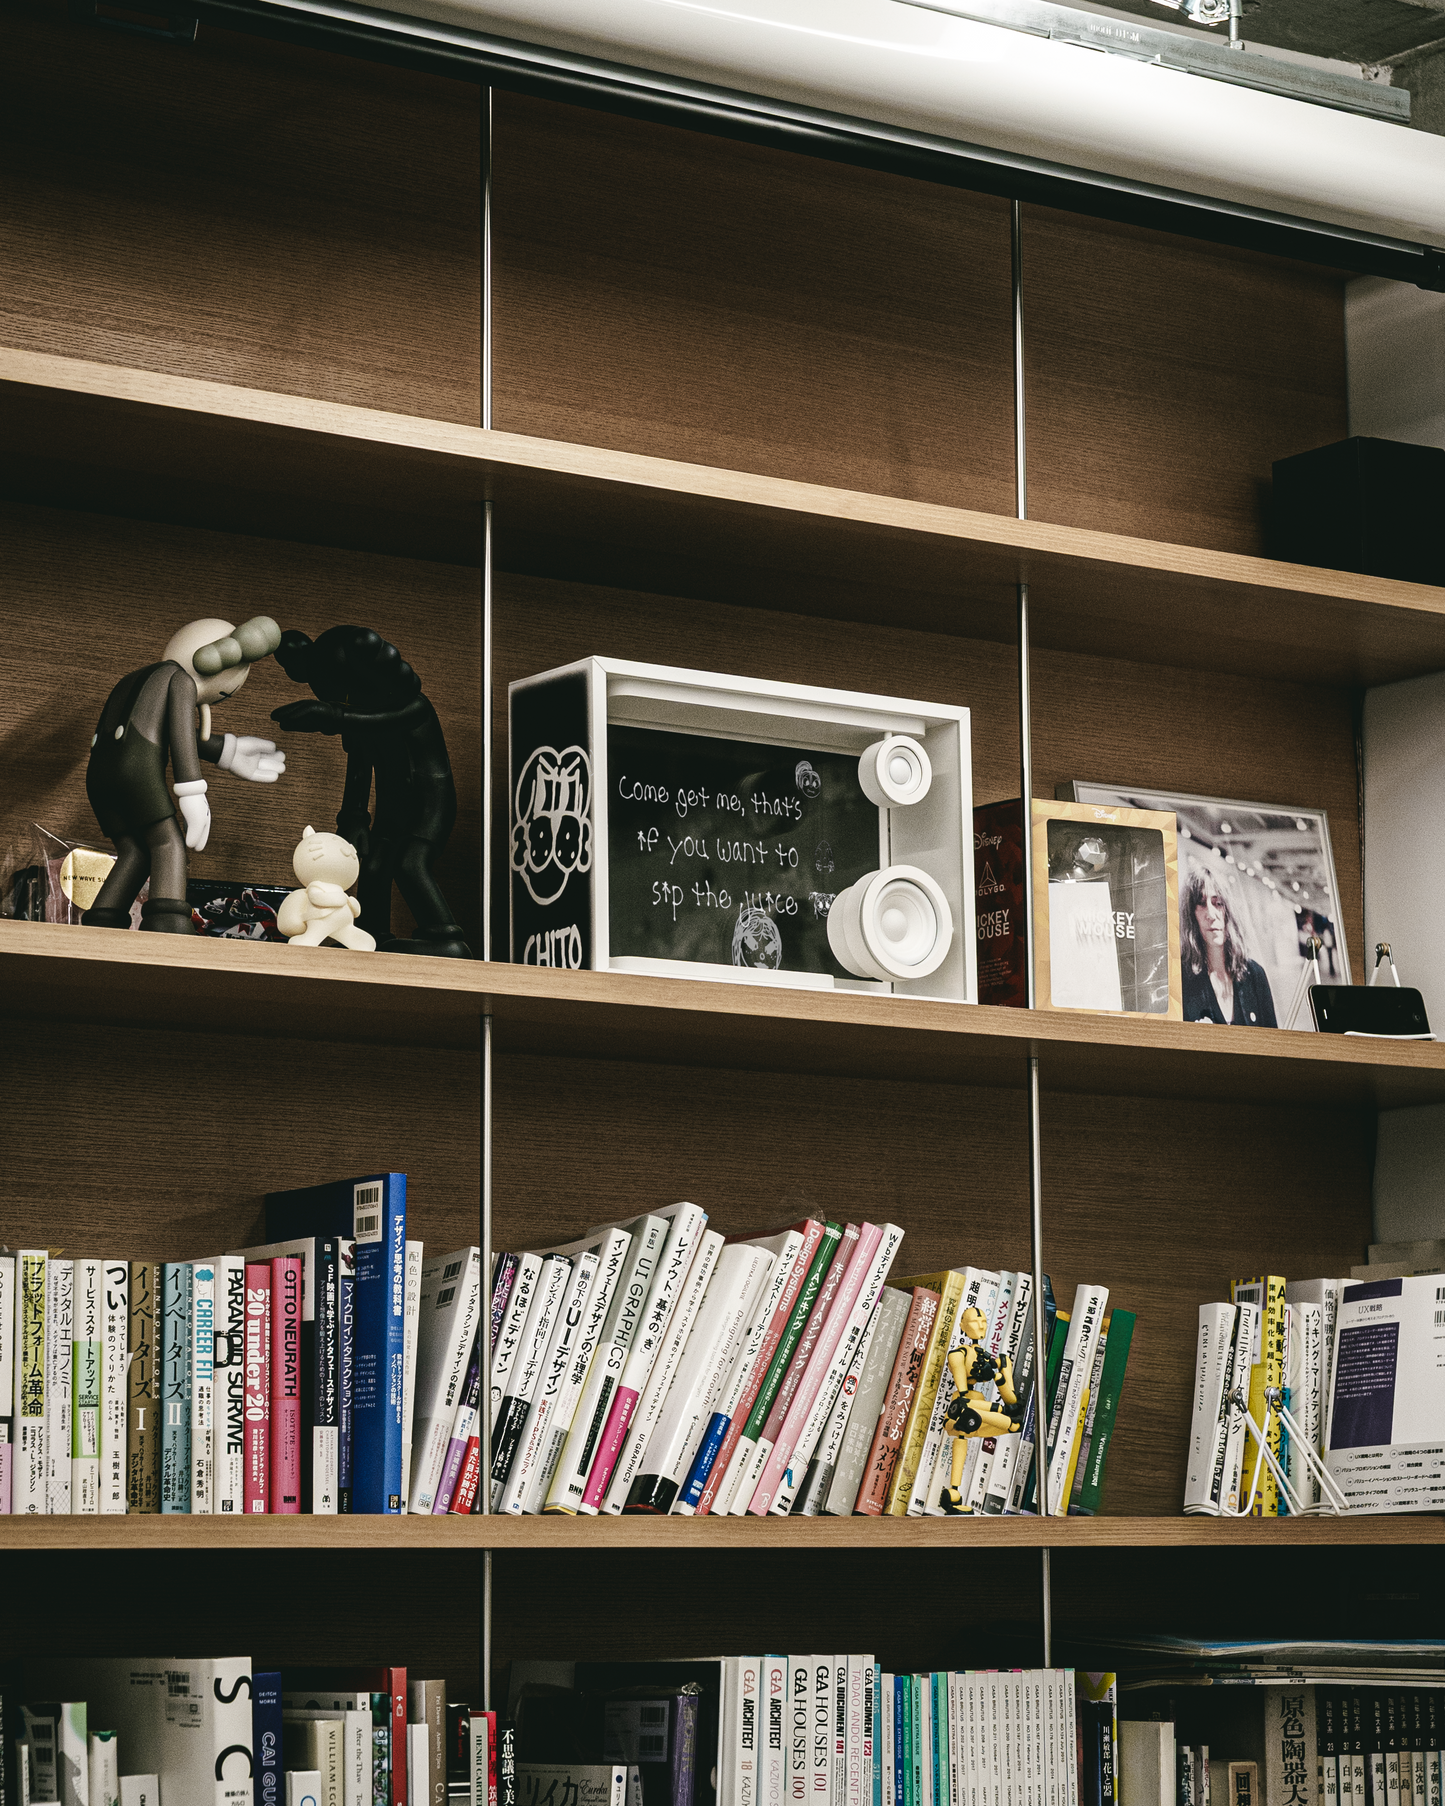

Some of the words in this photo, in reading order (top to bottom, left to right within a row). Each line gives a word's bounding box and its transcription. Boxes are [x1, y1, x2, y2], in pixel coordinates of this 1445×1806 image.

[618, 775, 669, 804] Come
[676, 786, 710, 818] get
[716, 790, 746, 816] me,
[751, 791, 802, 820] that's
[1091, 807, 1117, 821] Disney
[637, 827, 659, 852] if
[668, 836, 708, 864] you
[717, 836, 768, 865] want
[774, 841, 800, 868] to
[79, 875, 96, 883] WAVE
[652, 879, 684, 922] sip
[691, 879, 731, 910] the
[739, 890, 798, 928] juice
[977, 909, 1010, 928] ICKEY
[524, 922, 582, 968] CHITO
[978, 925, 1010, 941] OUSE
[392, 1215, 404, 1316] デザイン思考の教科書
[635, 1257, 653, 1279] UI
[798, 1229, 820, 1268] Design
[247, 1288, 265, 1316] 20
[284, 1269, 297, 1315] OTTO
[406, 1251, 420, 1316] 配色の設計
[639, 1236, 689, 1355] レイアウト、基本の「き」
[746, 1244, 798, 1356] デザインはストーリーテリング
[779, 1265, 805, 1313] Systems
[792, 1263, 824, 1331] IAシンキング
[913, 1295, 923, 1317] WHAT
[85, 1266, 96, 1389] サービス・スタートアップ
[196, 1299, 213, 1354] CAREER
[228, 1268, 243, 1366] PARANOID
[496, 1267, 536, 1374] なるほどデザイン
[518, 1266, 564, 1397] オブジェクト指向UIデザイン
[570, 1238, 626, 1385] インタフェースデザインの心理学
[607, 1283, 644, 1370] GRAPHICS
[795, 1262, 844, 1370] モバイルIAシンキング
[1358, 1303, 1383, 1315] UX戦略
[29, 1259, 45, 1417] プラットフォーム革命
[60, 1266, 73, 1399] デジタルエコノミー
[107, 1314, 116, 1393] 体験のつくりかた
[132, 1266, 153, 1399] イノベーターズ
[165, 1268, 186, 1400] イノベーターズ
[246, 1318, 264, 1391] under
[325, 1264, 335, 1423] SF映画で学ぶインタフェースデザイン
[342, 1282, 354, 1408] マイクロインタラクション
[545, 1269, 591, 1396] 縁の下のUIデザイン
[720, 1309, 744, 1356] Designing
[904, 1318, 916, 1350] MATTERS
[196, 1360, 213, 1383] FIT
[284, 1318, 296, 1397] NEURATH
[714, 1356, 726, 1370] for
[889, 1297, 938, 1441] 経営は何をすべきか
[1310, 1309, 1321, 1444] ハッキング・マーケティング
[227, 1371, 243, 1455] SURVIVE
[246, 1394, 264, 1421] 20
[639, 1433, 646, 1442] UI
[874, 1444, 889, 1472] ハメル
[112, 1451, 120, 1500] 玉樹真一郎
[130, 1453, 139, 1508] デジタル革命史
[163, 1448, 171, 1502] デジタル革命史
[196, 1459, 205, 1499] 石倉秀明
[622, 1442, 643, 1484] GRAPHICS
[568, 1484, 584, 1496] BNN
[743, 1669, 756, 1696] GA
[770, 1668, 783, 1696] GA
[794, 1668, 808, 1697] GA
[815, 1665, 830, 1693] GA
[836, 1667, 846, 1686] GA
[851, 1669, 861, 1707] TADAO
[864, 1667, 874, 1686] GA
[741, 1697, 755, 1750] ARCHITECT
[769, 1697, 782, 1750] ARCHITECT
[792, 1699, 807, 1770] HOUSES
[814, 1696, 829, 1768] HOUSES
[835, 1686, 845, 1739] DOCUMENT
[851, 1710, 860, 1744] ANDO
[863, 1686, 873, 1739] DOCUMENT
[262, 1731, 276, 1766] CAI
[329, 1730, 337, 1784] WILLIAM
[377, 1729, 386, 1755] Olivo
[835, 1740, 844, 1755] 141
[863, 1740, 872, 1757] 123
[1279, 1693, 1309, 1806] 原色陶器大
[1355, 1741, 1361, 1750] 2
[1388, 1738, 1395, 1747] 4
[741, 1760, 753, 1771] 18
[769, 1759, 780, 1799] KAZUYO
[792, 1776, 806, 1800] 100
[813, 1773, 827, 1792] 101
[849, 1747, 859, 1794] RECENT
[1342, 1765, 1352, 1794] 白磁
[1354, 1766, 1364, 1795] 弥生
